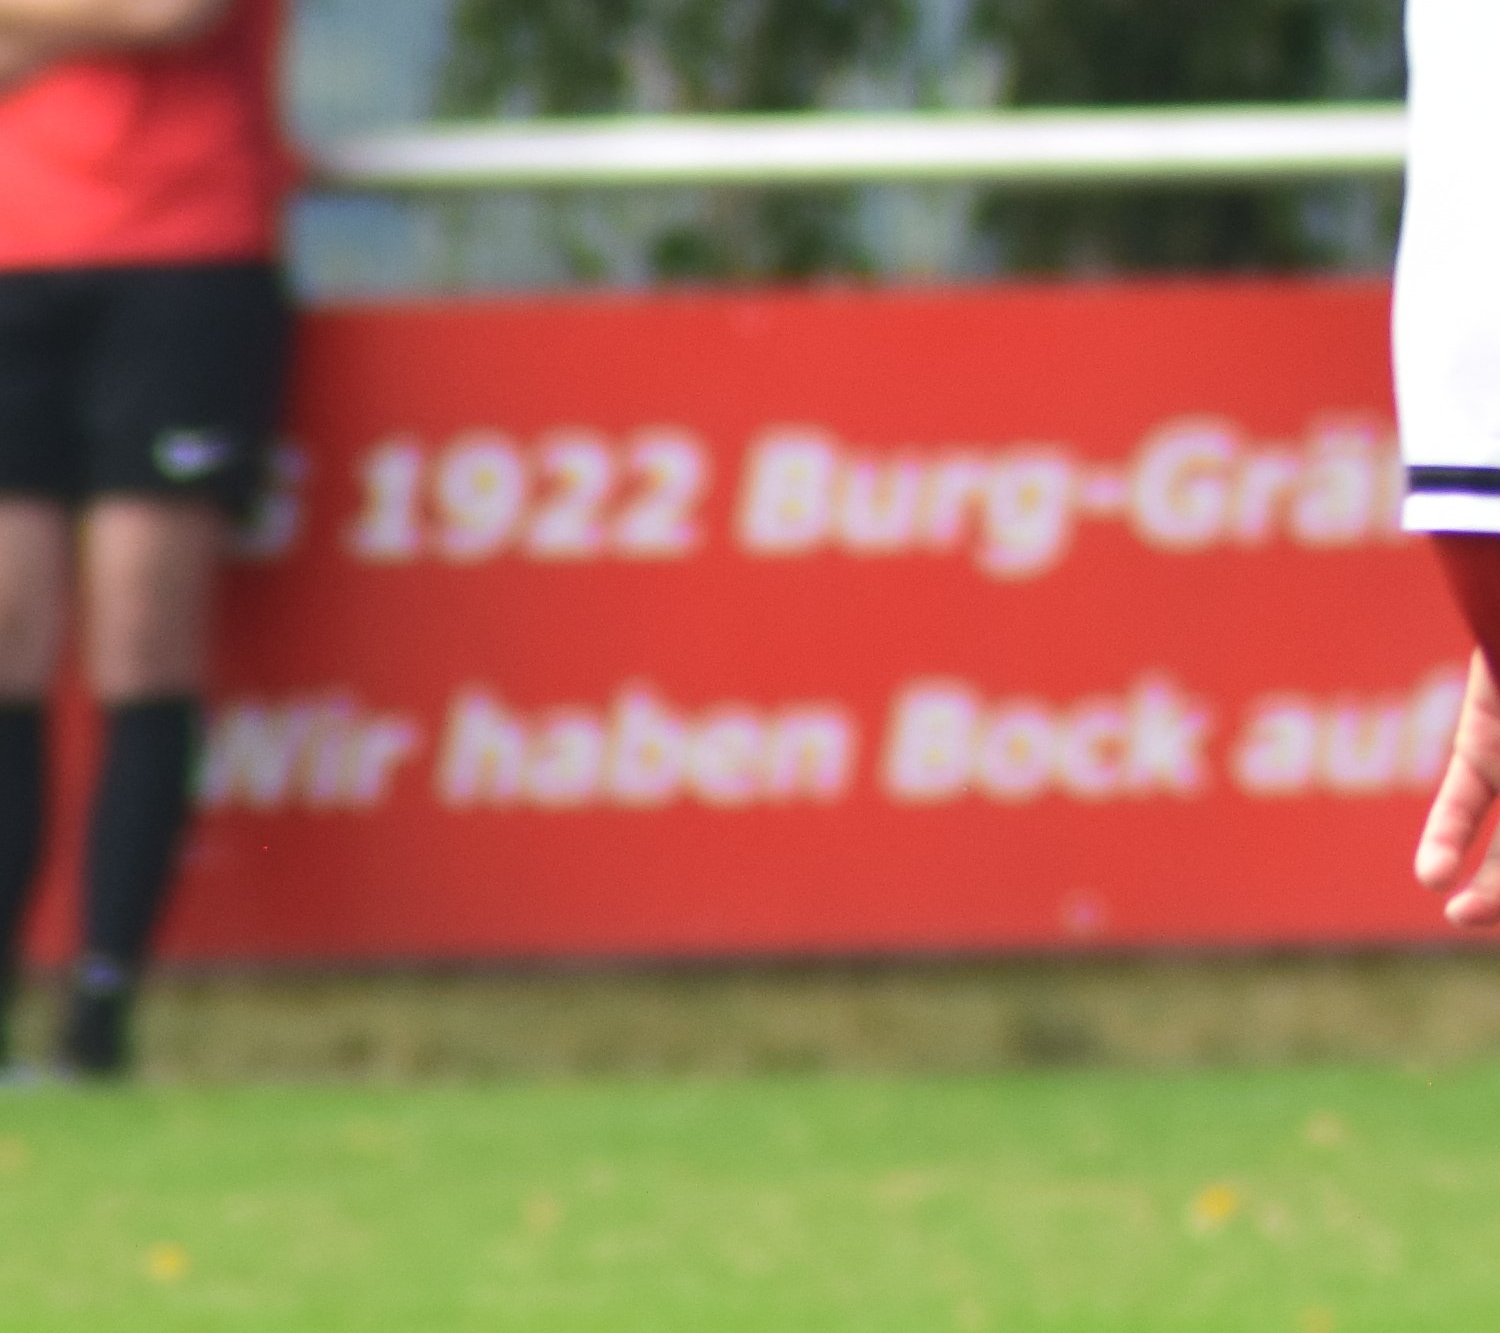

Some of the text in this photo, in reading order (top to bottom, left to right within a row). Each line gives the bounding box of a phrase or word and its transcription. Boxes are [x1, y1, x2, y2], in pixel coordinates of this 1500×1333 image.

[353, 431, 702, 559] 1922
[198, 673, 1466, 807] Wir haben Bock auf
